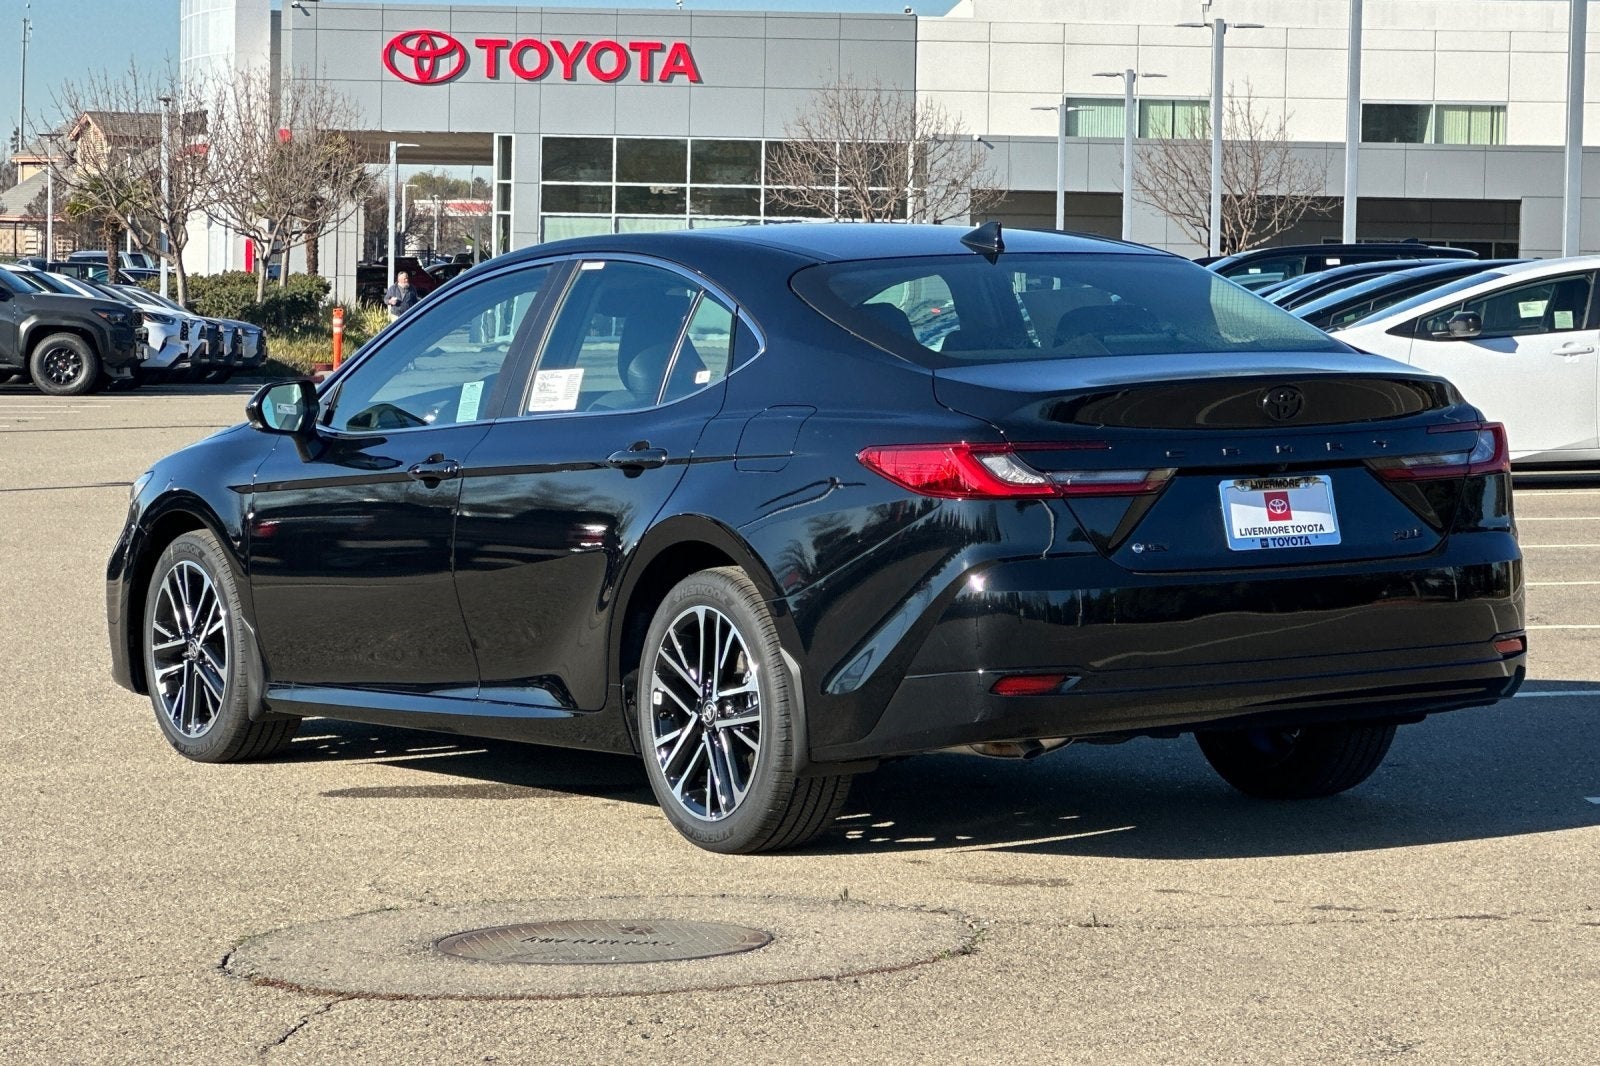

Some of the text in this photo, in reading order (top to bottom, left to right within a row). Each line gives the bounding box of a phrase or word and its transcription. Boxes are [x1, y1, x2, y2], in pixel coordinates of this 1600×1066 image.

[475, 38, 701, 84] TOYOTA
[1250, 479, 1301, 490] LIVERMORE
[1240, 523, 1325, 537] LIVERMORE TOYOTA
[1270, 536, 1312, 548] TOYOTA
